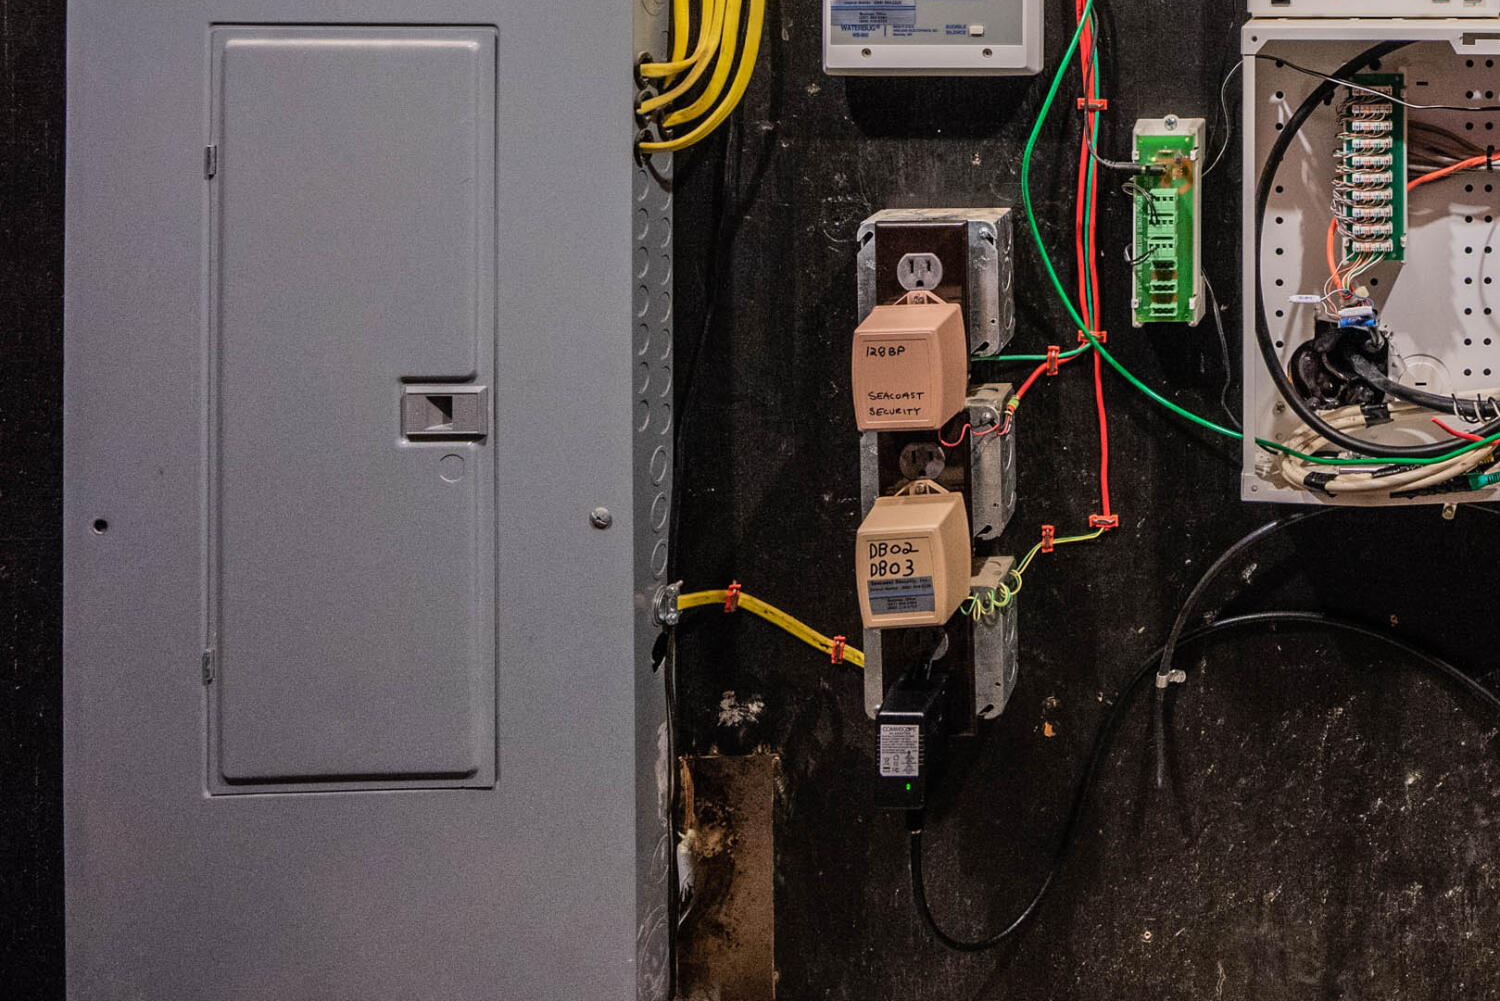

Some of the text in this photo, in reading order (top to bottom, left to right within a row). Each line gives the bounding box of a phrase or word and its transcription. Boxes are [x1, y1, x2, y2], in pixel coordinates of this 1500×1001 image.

[867, 391, 925, 401] SEACOAST
[868, 407, 922, 416] SECURITY
[869, 559, 916, 577] DB03
